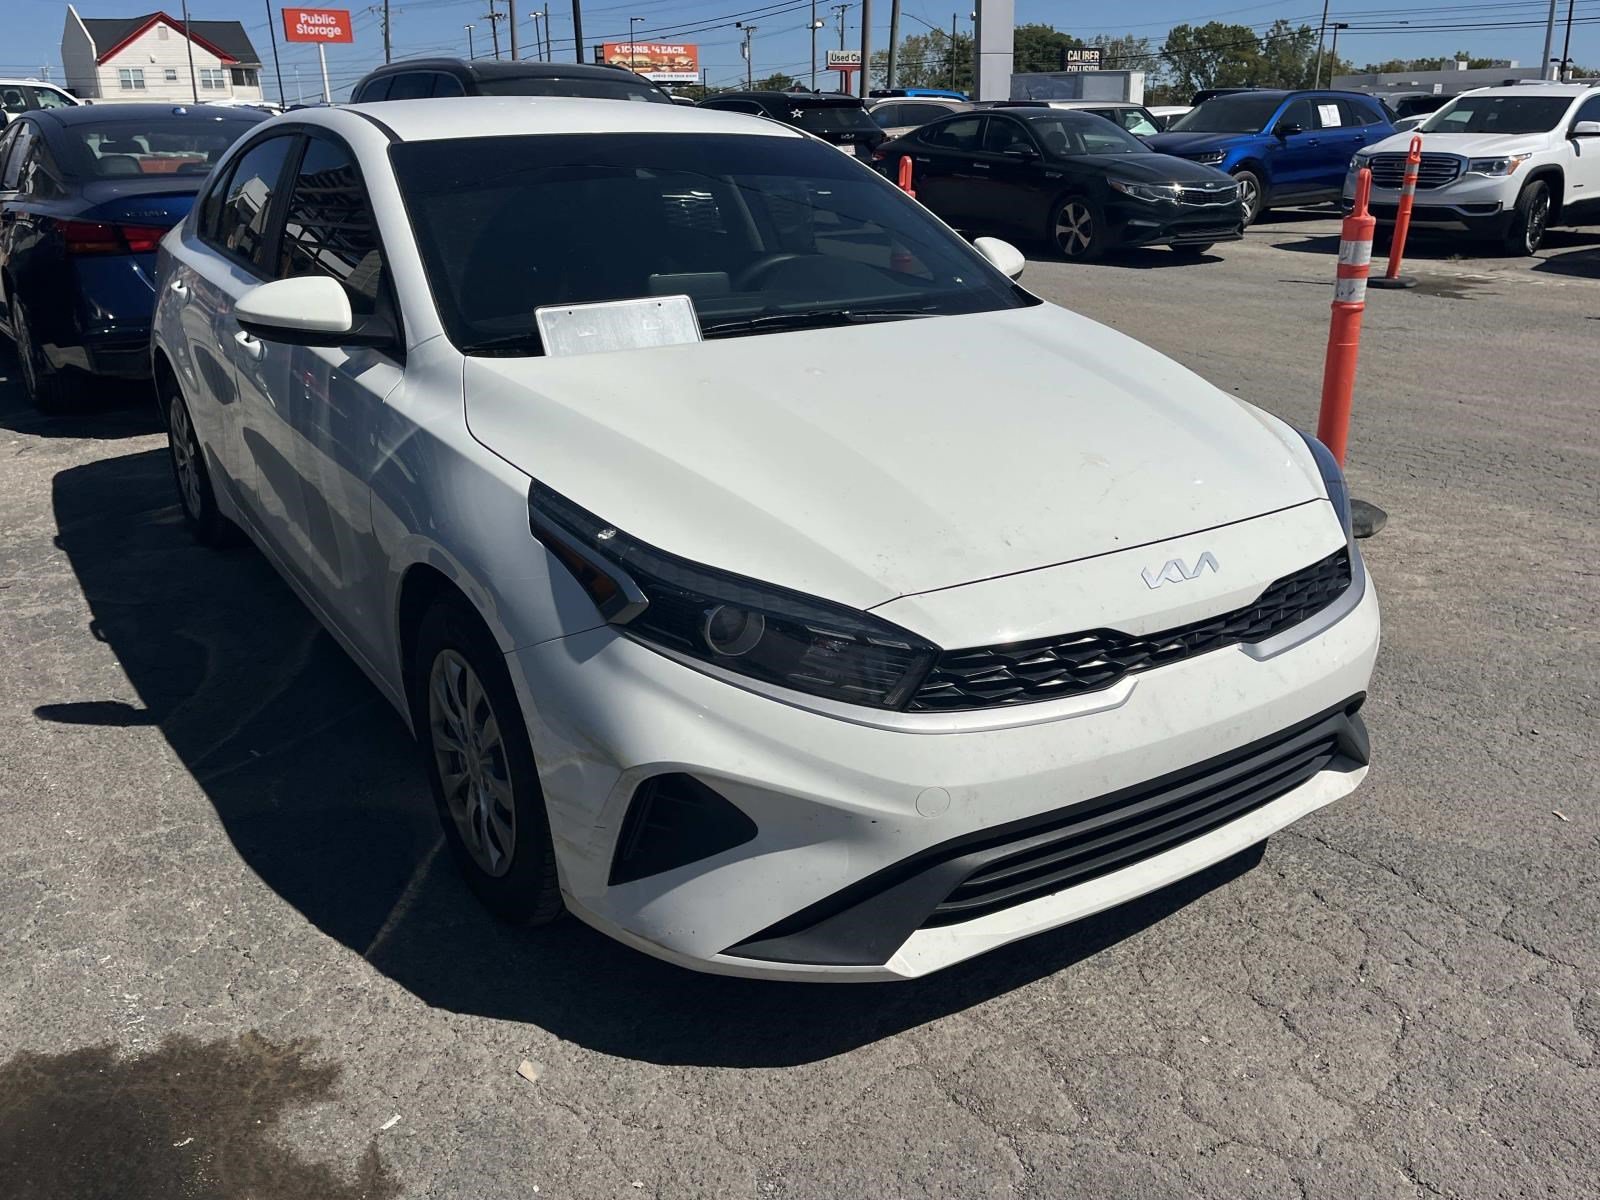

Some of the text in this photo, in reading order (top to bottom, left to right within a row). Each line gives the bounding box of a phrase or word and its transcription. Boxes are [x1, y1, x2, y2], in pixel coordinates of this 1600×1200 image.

[300, 13, 336, 24] Public
[296, 24, 342, 38] Storage
[614, 46, 620, 54] 4
[660, 46, 687, 54] EACH.
[831, 54, 849, 62] Used
[1067, 50, 1100, 62] CALIBER
